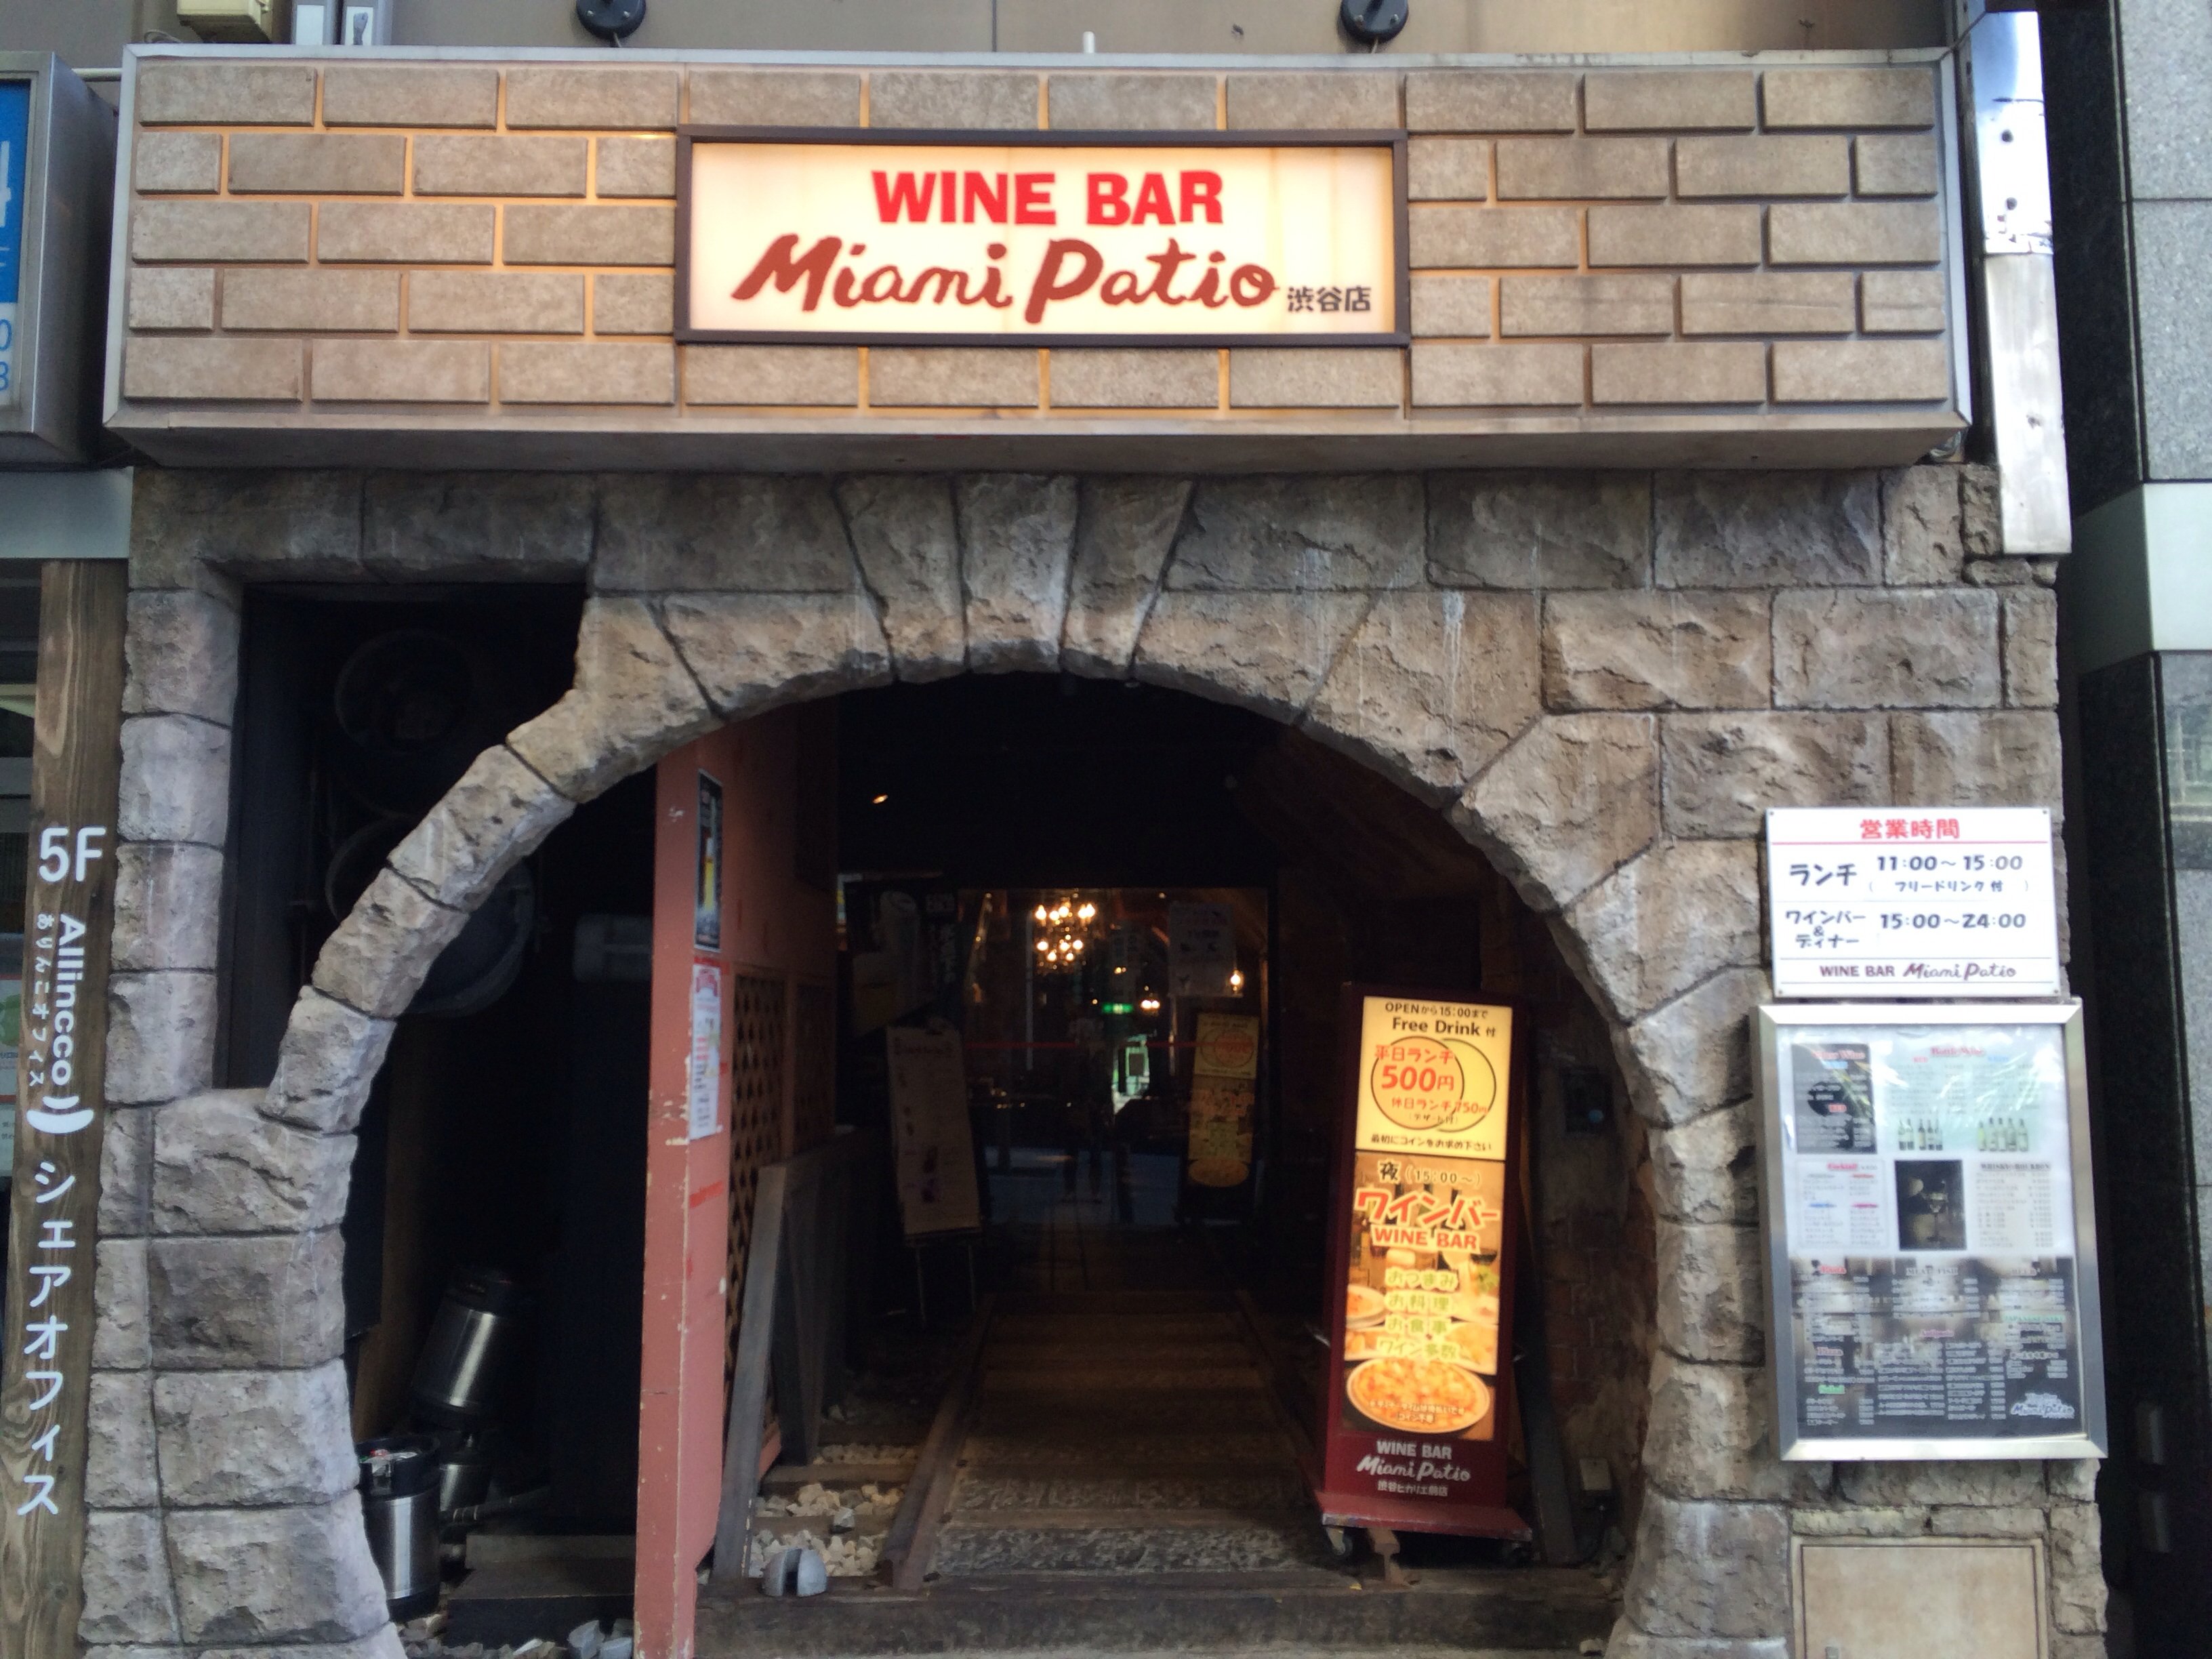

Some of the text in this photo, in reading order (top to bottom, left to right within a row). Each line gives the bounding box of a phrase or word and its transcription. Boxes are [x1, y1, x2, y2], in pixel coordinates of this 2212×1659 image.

[871, 171, 1223, 224] WINE BAR
[731, 233, 1279, 324] Miami Patio
[1288, 285, 1372, 312] 渋谷店
[1860, 819, 1959, 840] 営業時間
[39, 826, 106, 882] 5F
[1789, 863, 1858, 886] ランチ
[1786, 911, 1866, 924] ワインバー
[1795, 934, 1860, 949] ディナー
[1814, 926, 1824, 937] &
[1820, 963, 2017, 981] WINE BAR Miami Patio
[29, 914, 54, 1087] ありんこオフィス
[51, 914, 86, 1086] Allincco
[1393, 1017, 1428, 1031] Free
[1435, 1020, 1479, 1036] Drink
[1375, 1044, 1454, 1064] 平日ランチ
[1381, 1065, 1454, 1092] 500円
[1380, 1161, 1398, 1181] 夜
[1357, 1191, 1497, 1226] ワインバー
[1374, 1227, 1477, 1250] WINE BAR
[1389, 1270, 1454, 1289] おつまみ
[1376, 1439, 1452, 1460] WINE BAR
[1357, 1454, 1471, 1481] Miami Patio
